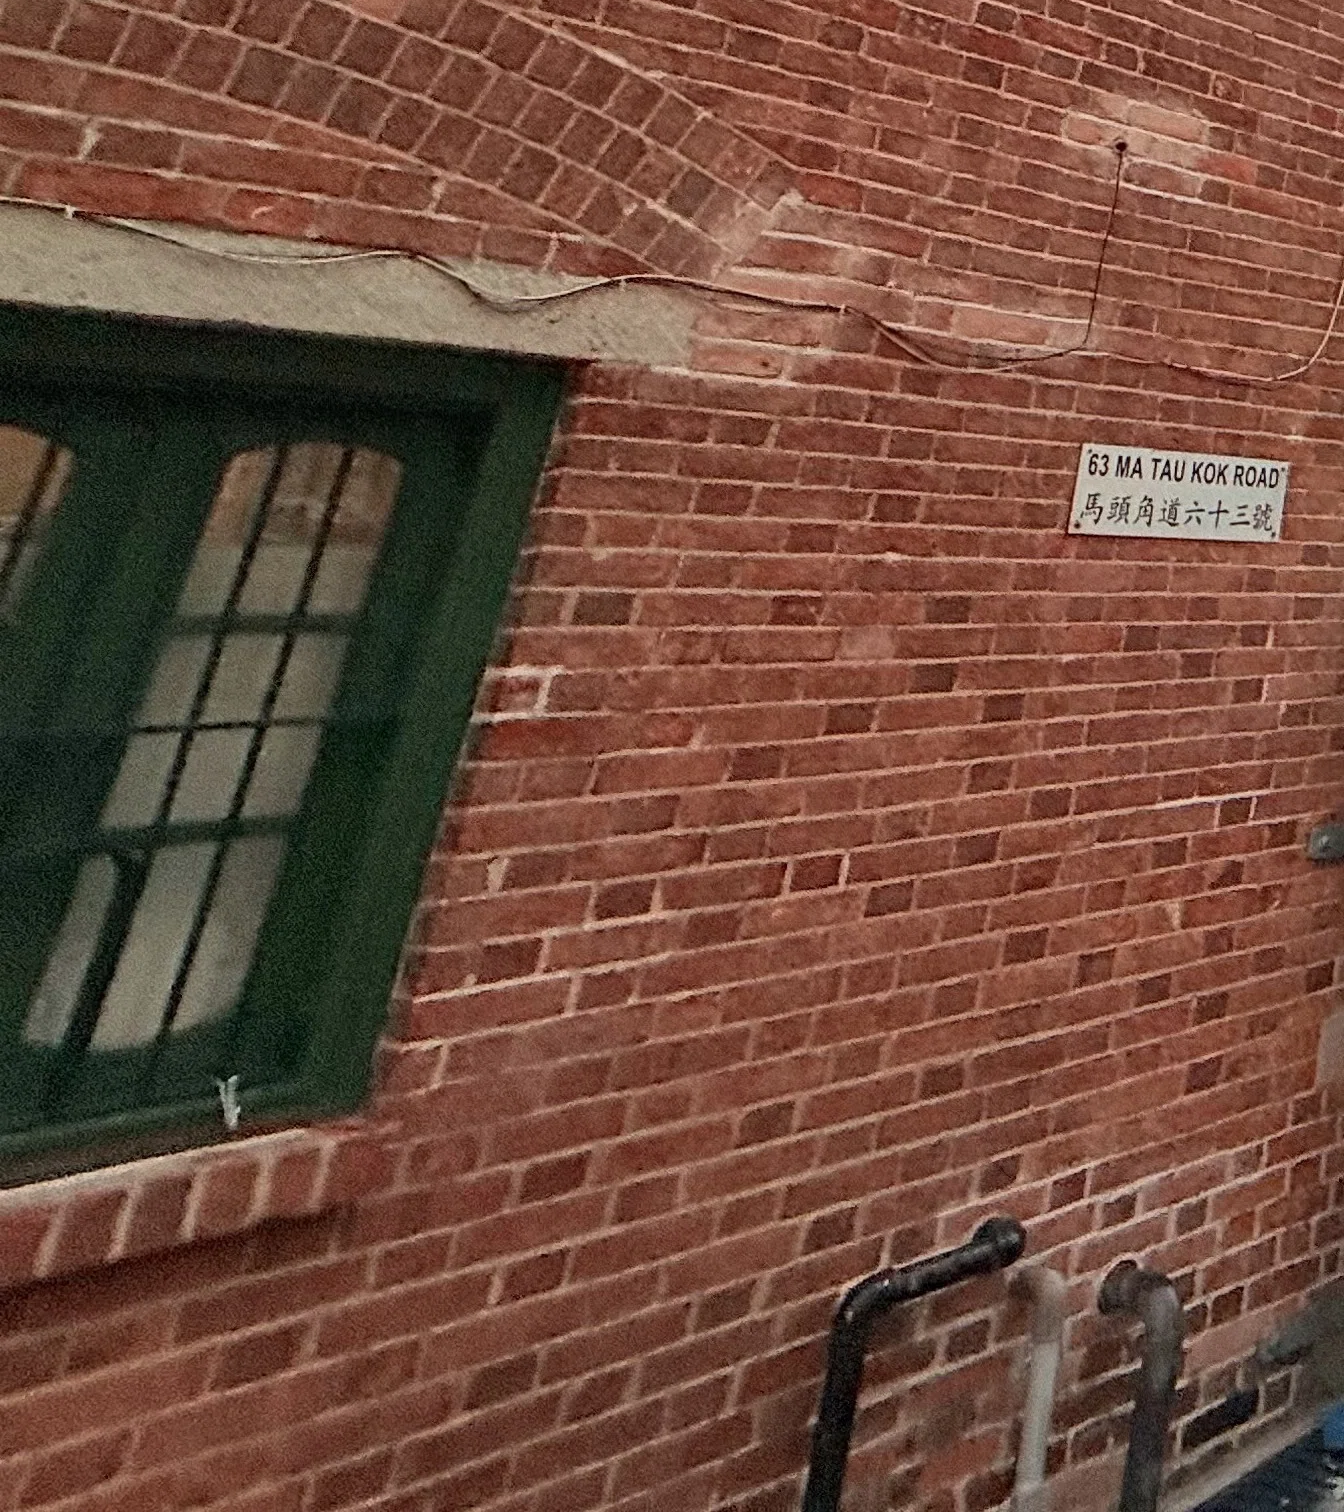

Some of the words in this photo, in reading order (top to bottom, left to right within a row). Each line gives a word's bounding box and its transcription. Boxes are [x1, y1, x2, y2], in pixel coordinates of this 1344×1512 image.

[1088, 453, 1110, 476] 63
[1115, 455, 1143, 479] MA
[1151, 458, 1185, 483] TAU
[1191, 461, 1230, 486] KOK
[1233, 465, 1279, 488] ROAD
[1080, 492, 1273, 532] 馬頭角道六十三號
